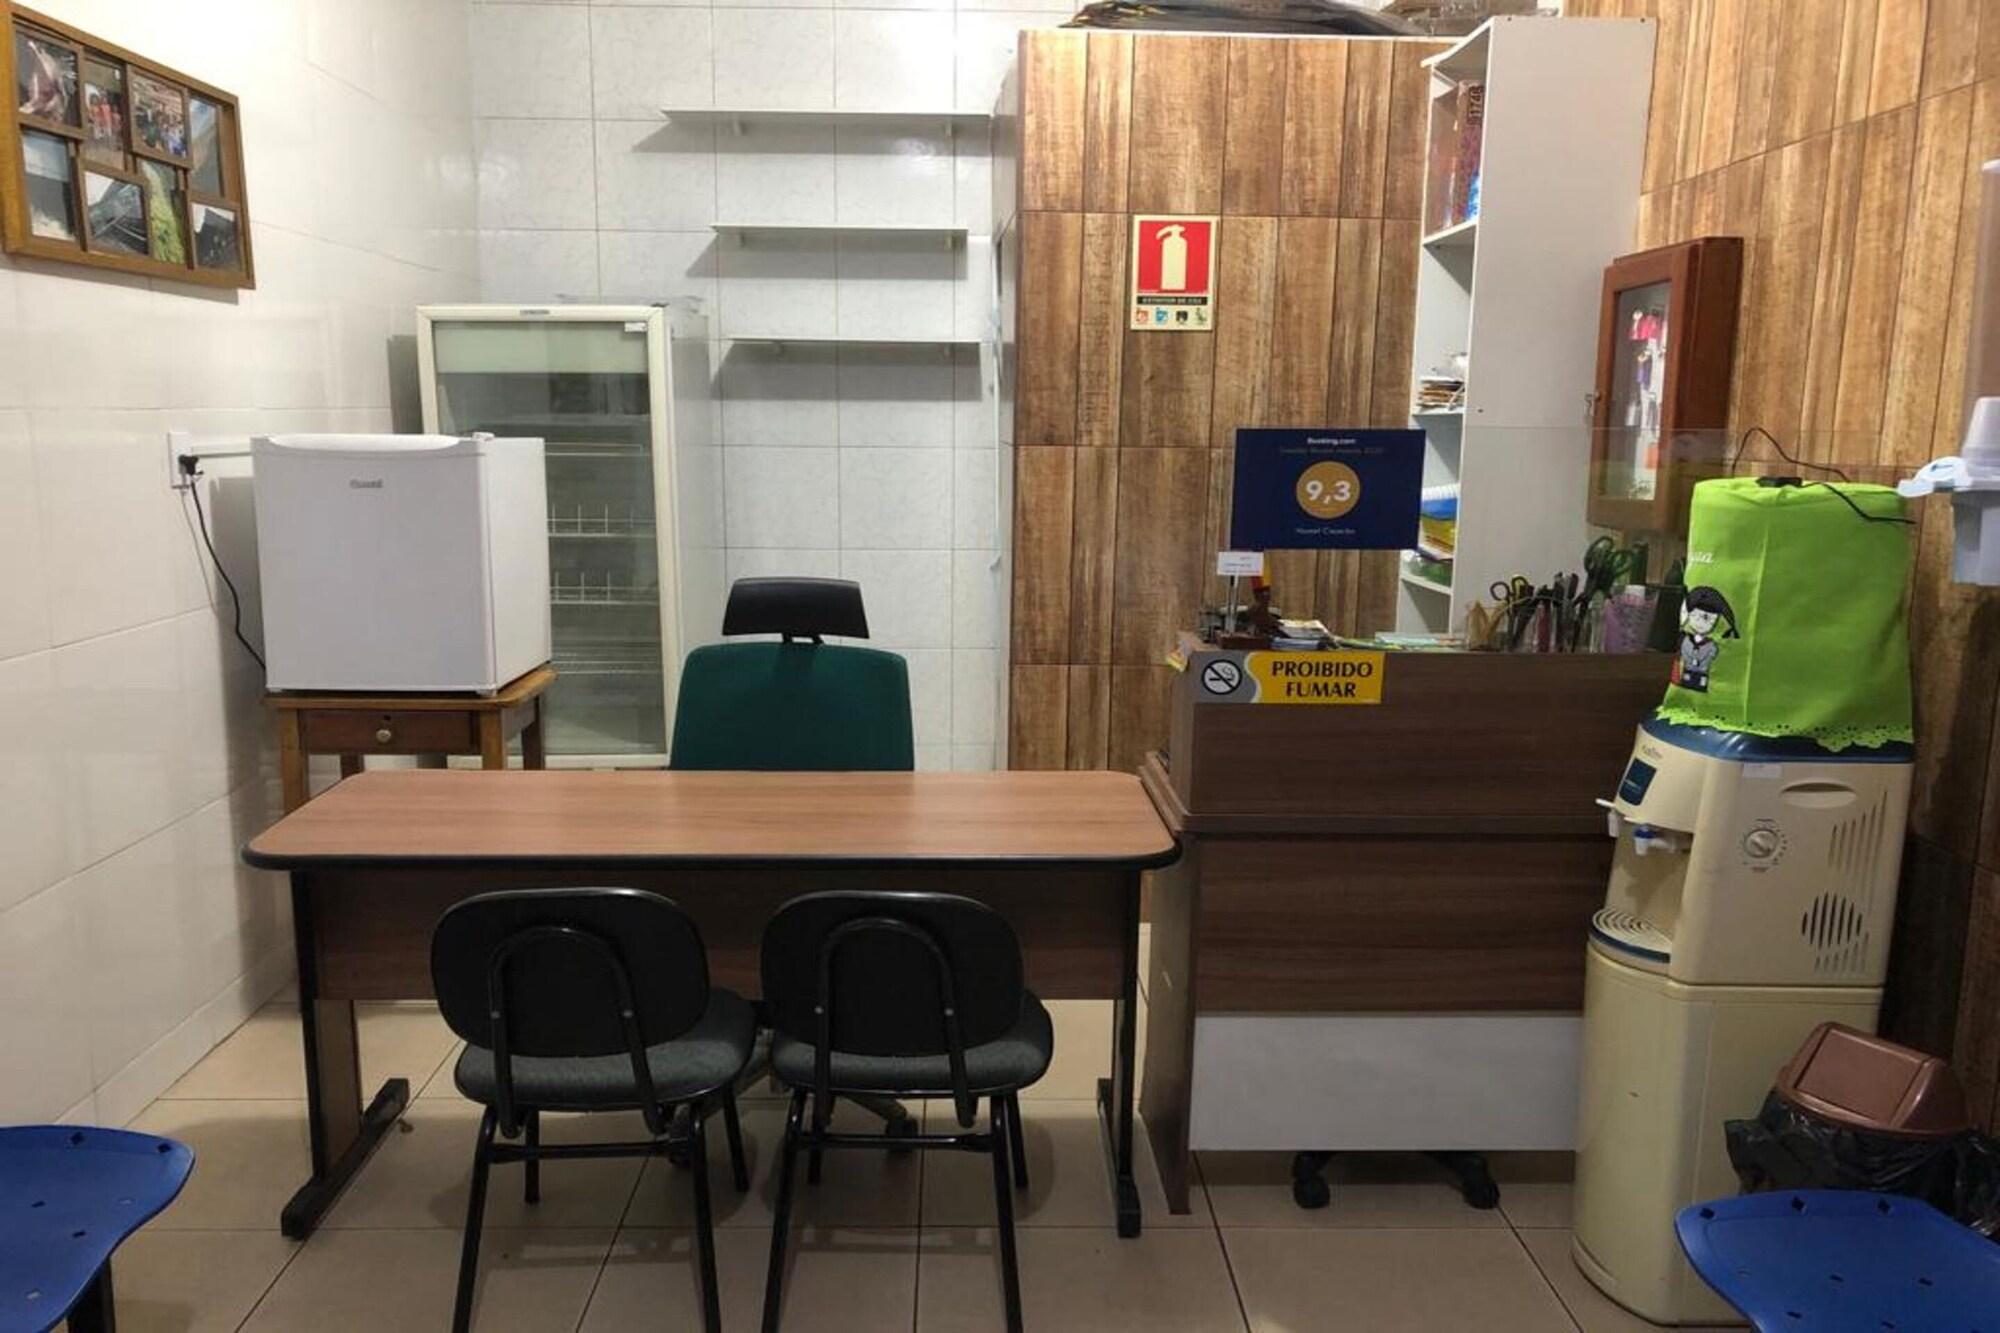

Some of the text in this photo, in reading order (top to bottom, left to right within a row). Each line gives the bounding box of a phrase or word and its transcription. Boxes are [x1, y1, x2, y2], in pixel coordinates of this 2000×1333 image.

[1307, 437, 1357, 445] Booking.com
[1306, 480, 1351, 505] 9,3
[1271, 661, 1373, 678] PROIBIDO
[1286, 681, 1356, 698] FUMAR
